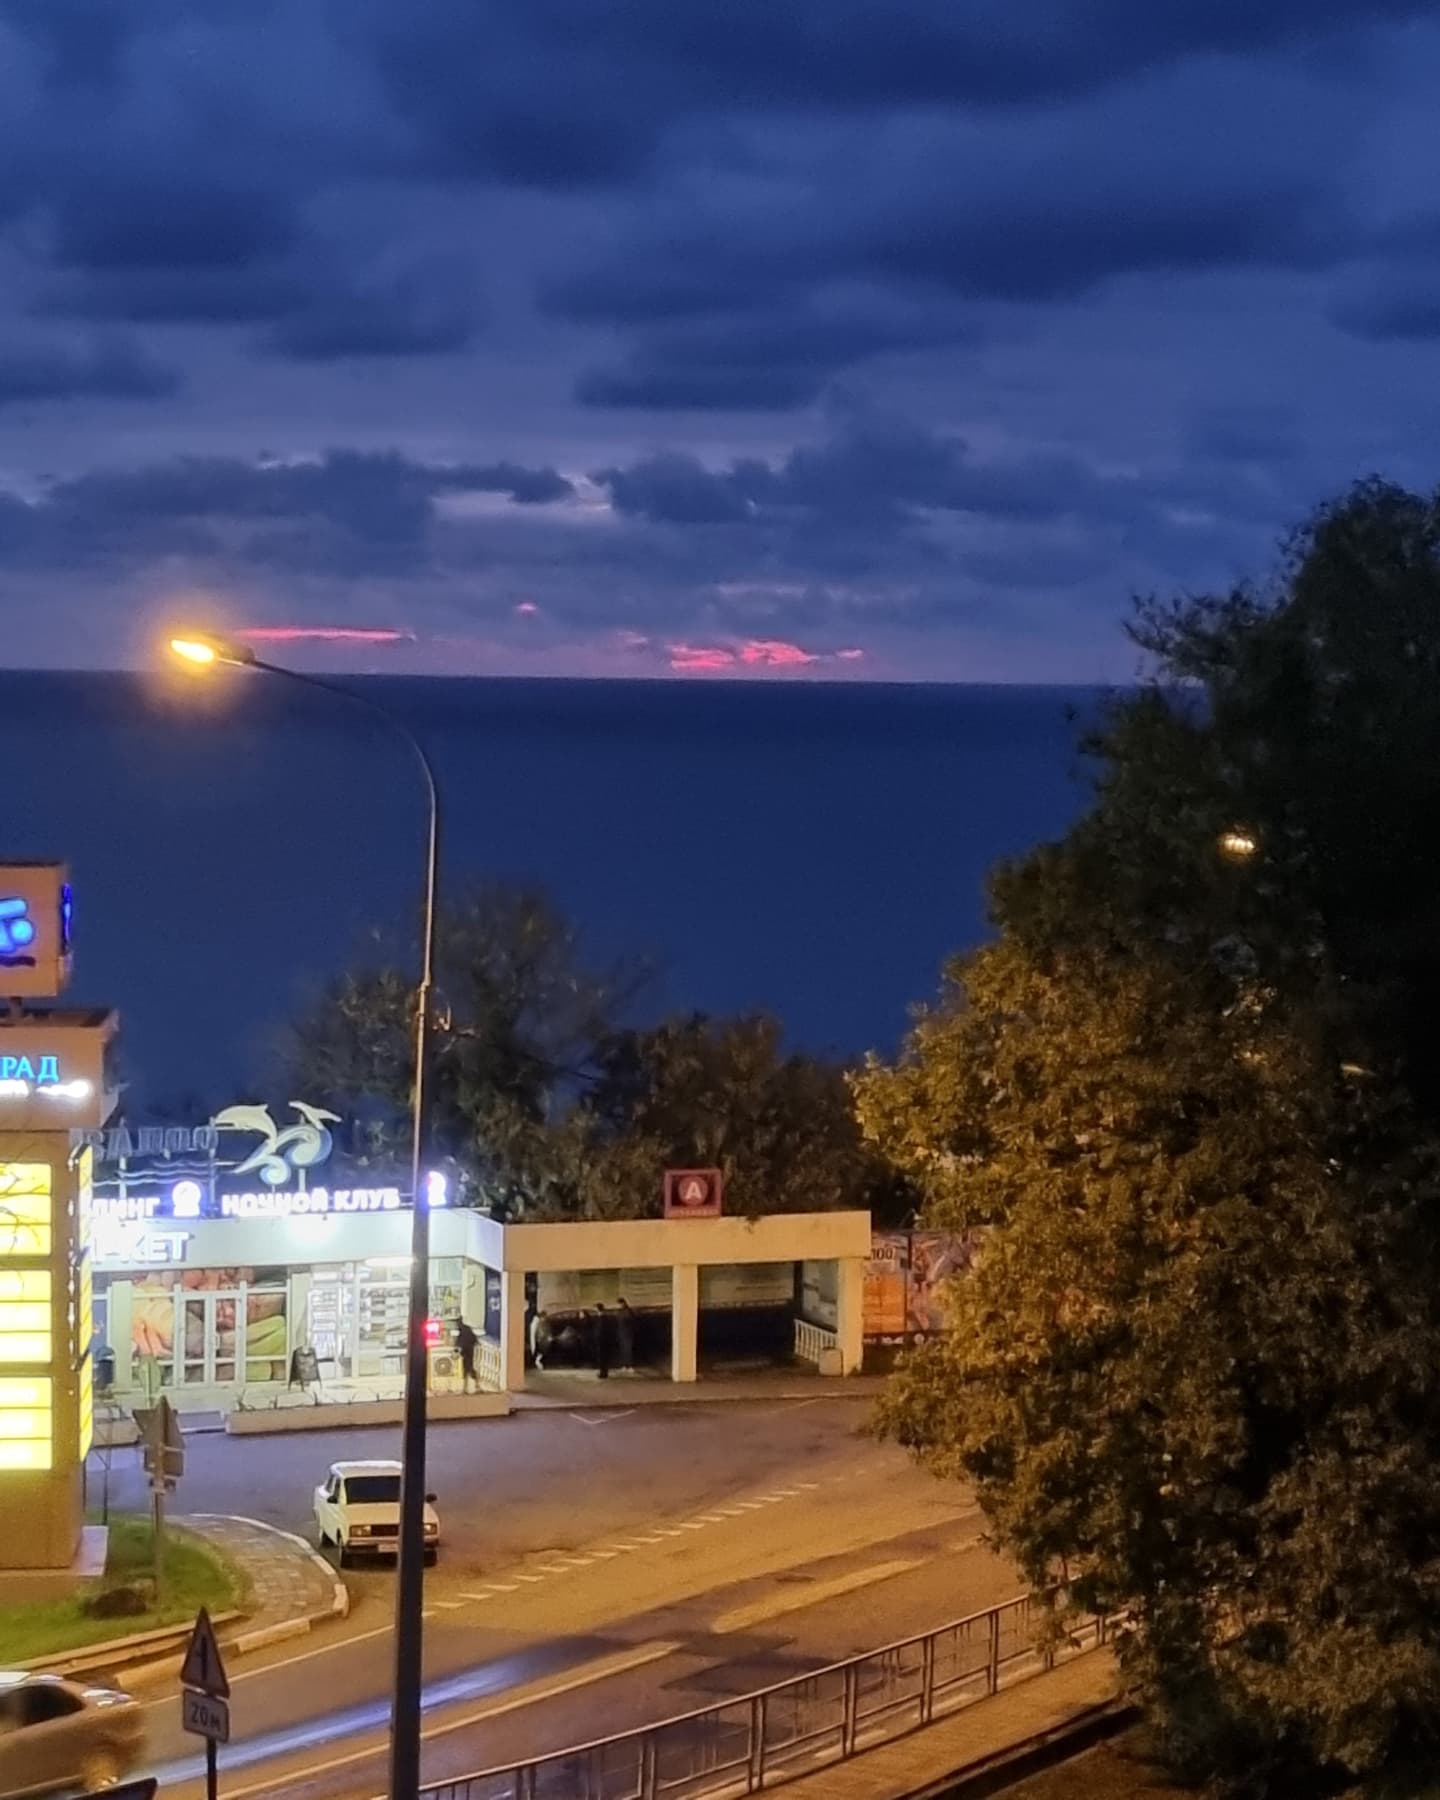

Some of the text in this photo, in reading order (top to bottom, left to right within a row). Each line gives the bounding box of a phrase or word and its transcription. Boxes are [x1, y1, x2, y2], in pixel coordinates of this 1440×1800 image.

[0, 1055, 60, 1084] РАД
[89, 1187, 401, 1217] ЛИНГ НОЧНОЙ КЛУБ
